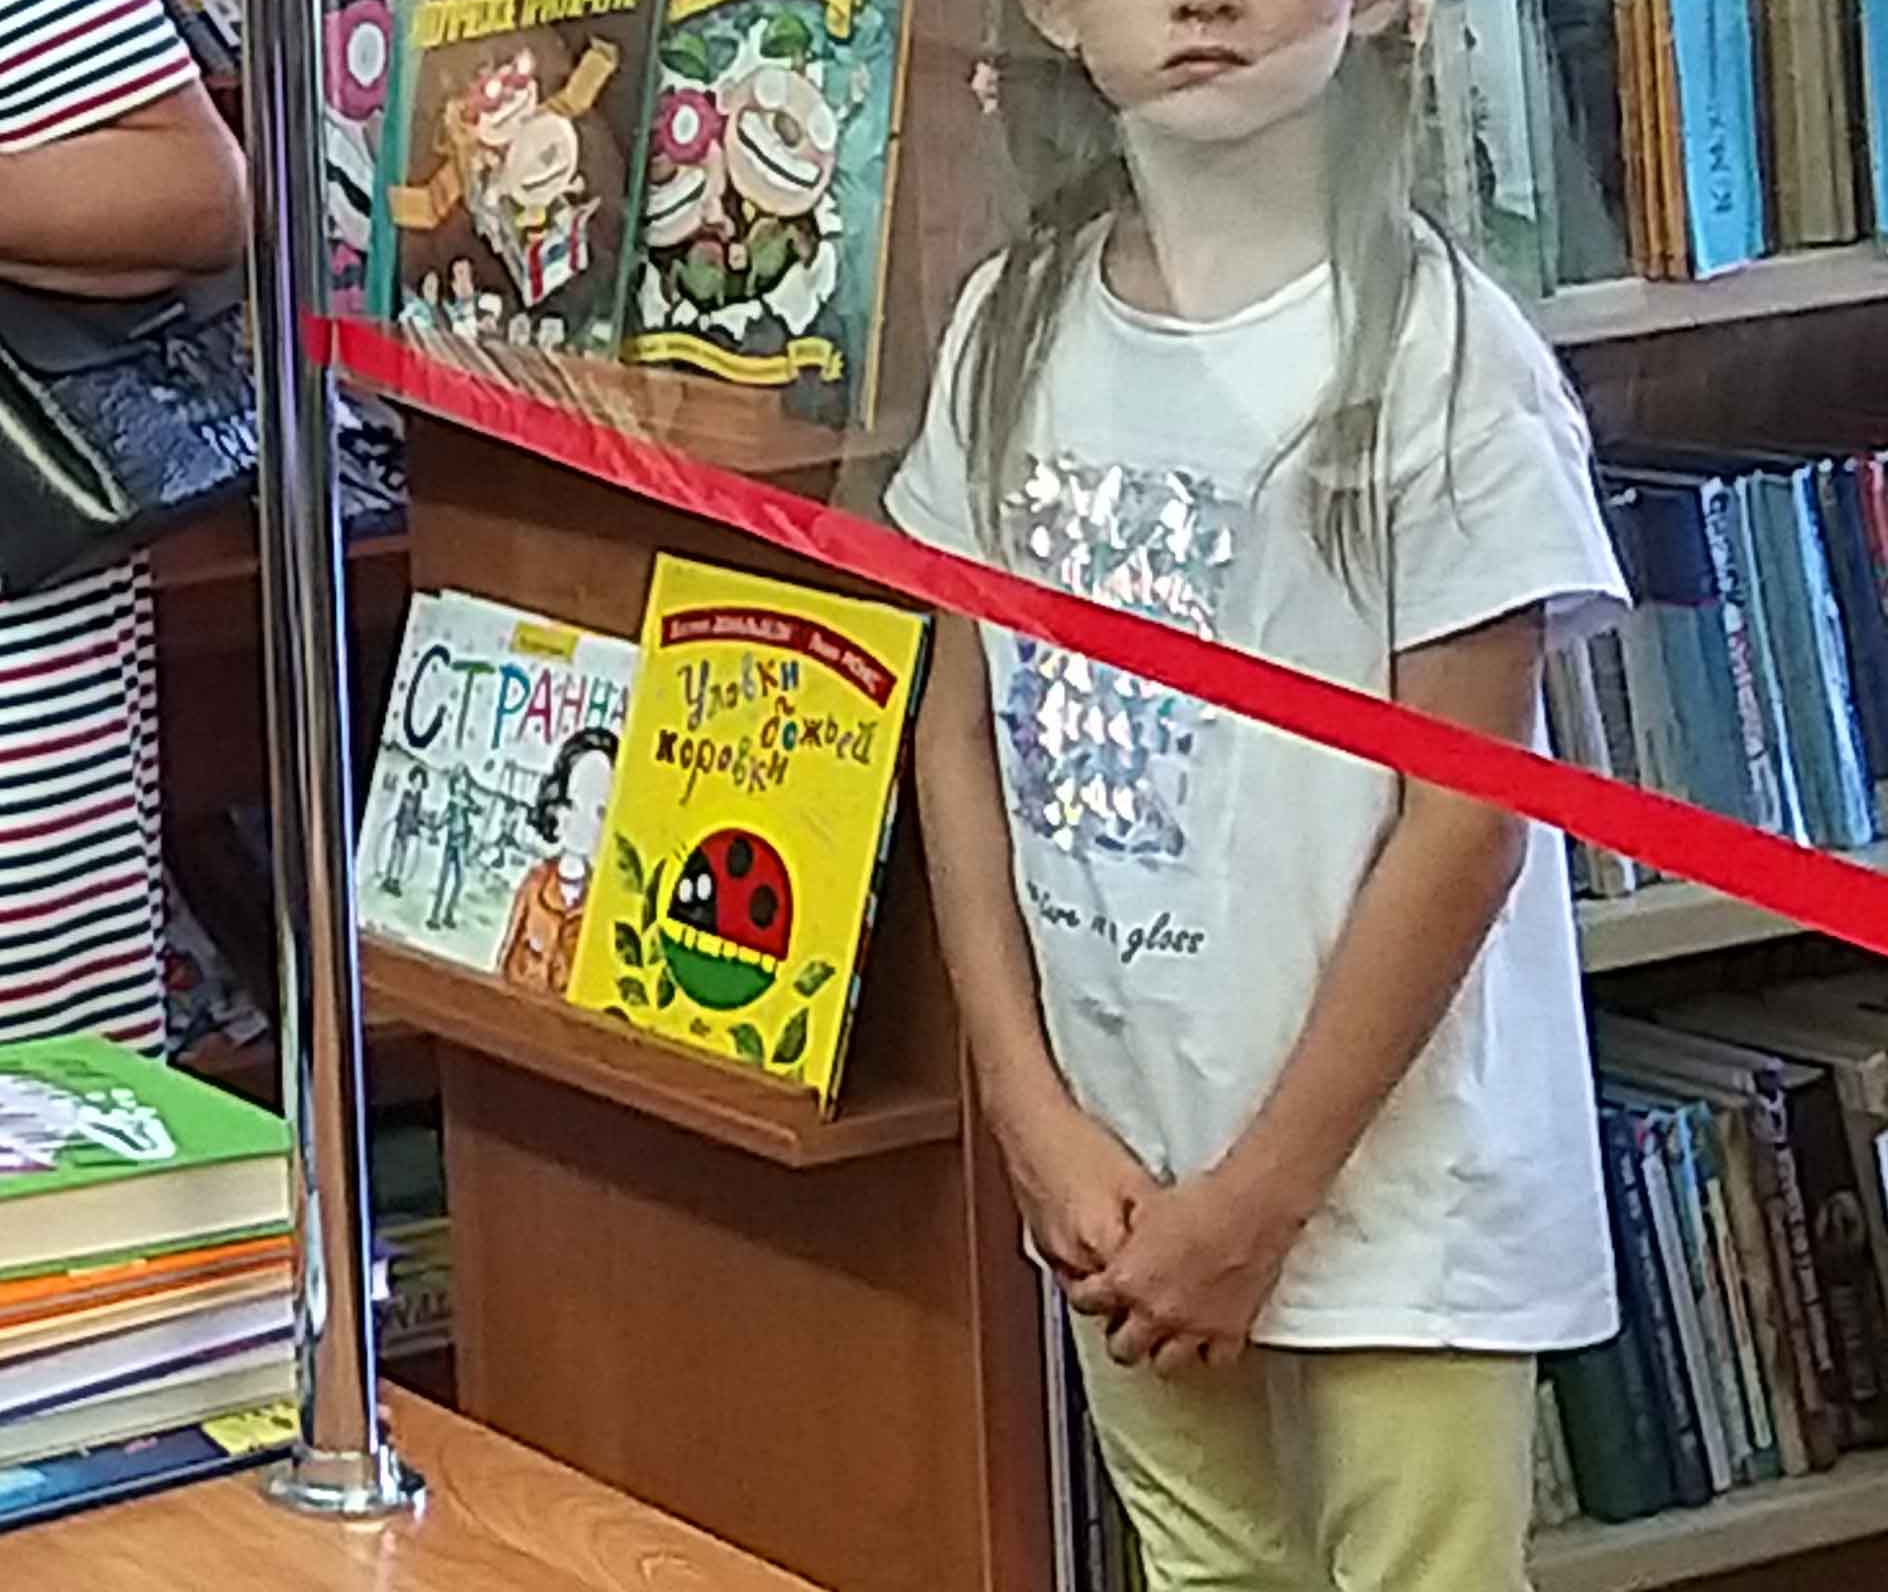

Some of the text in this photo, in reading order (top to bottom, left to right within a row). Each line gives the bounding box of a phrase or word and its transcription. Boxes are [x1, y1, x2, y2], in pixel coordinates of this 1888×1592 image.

[676, 650, 799, 733] Уловки
[655, 728, 790, 807] коровки
[760, 695, 879, 766] божьей
[1121, 912, 1205, 964] gloss
